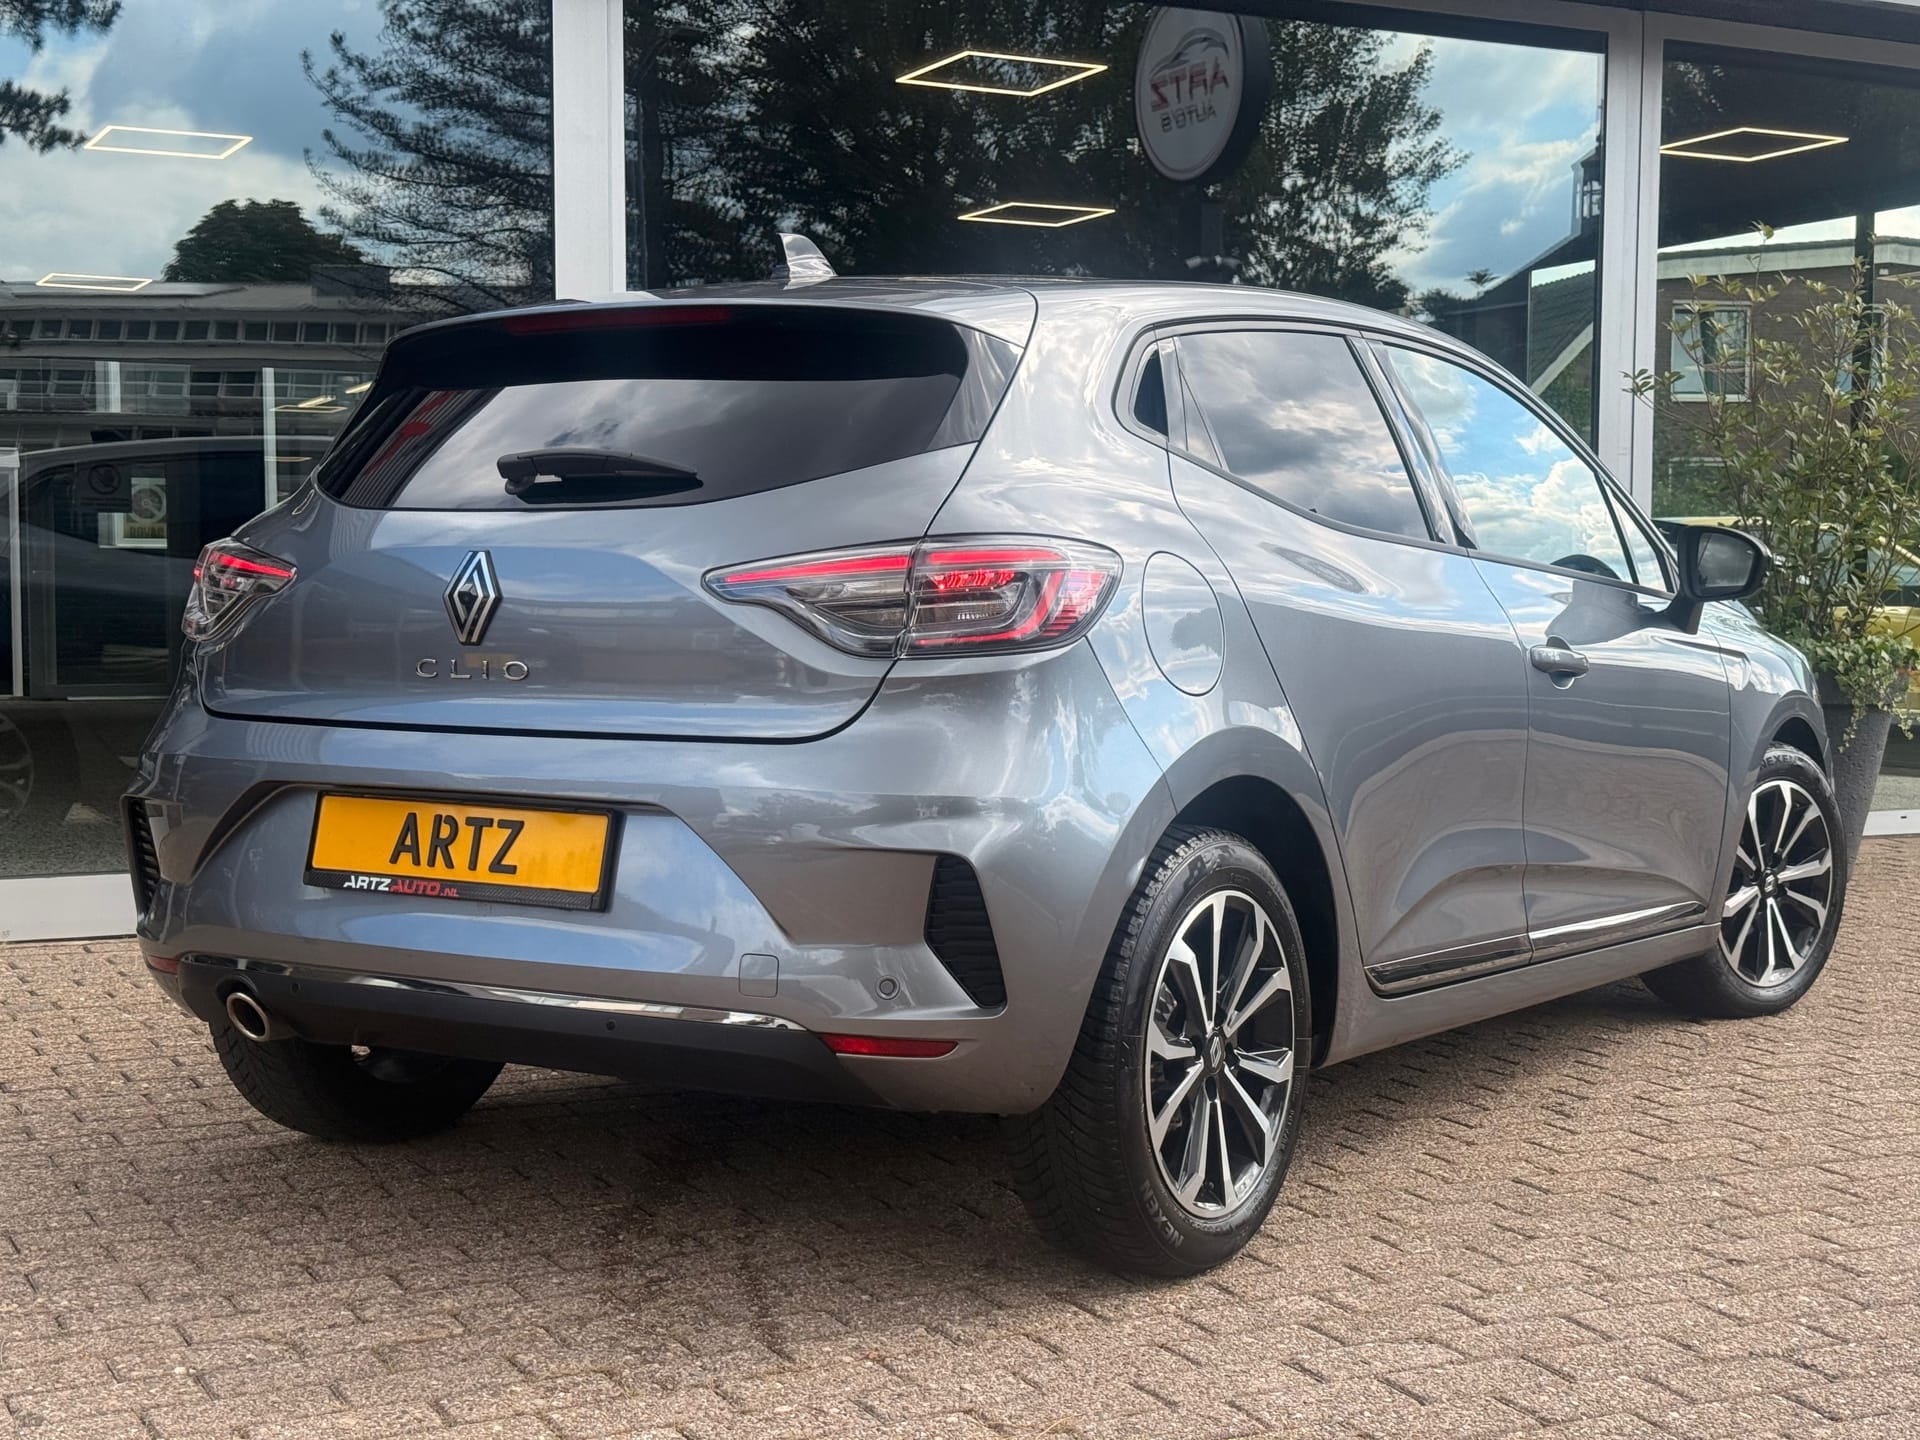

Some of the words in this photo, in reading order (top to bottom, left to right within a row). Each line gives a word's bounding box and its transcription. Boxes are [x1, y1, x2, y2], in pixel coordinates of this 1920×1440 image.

[416, 658, 529, 680] CLIO
[389, 812, 525, 875] ARTZ
[1141, 1180, 1184, 1247] NEXEN
